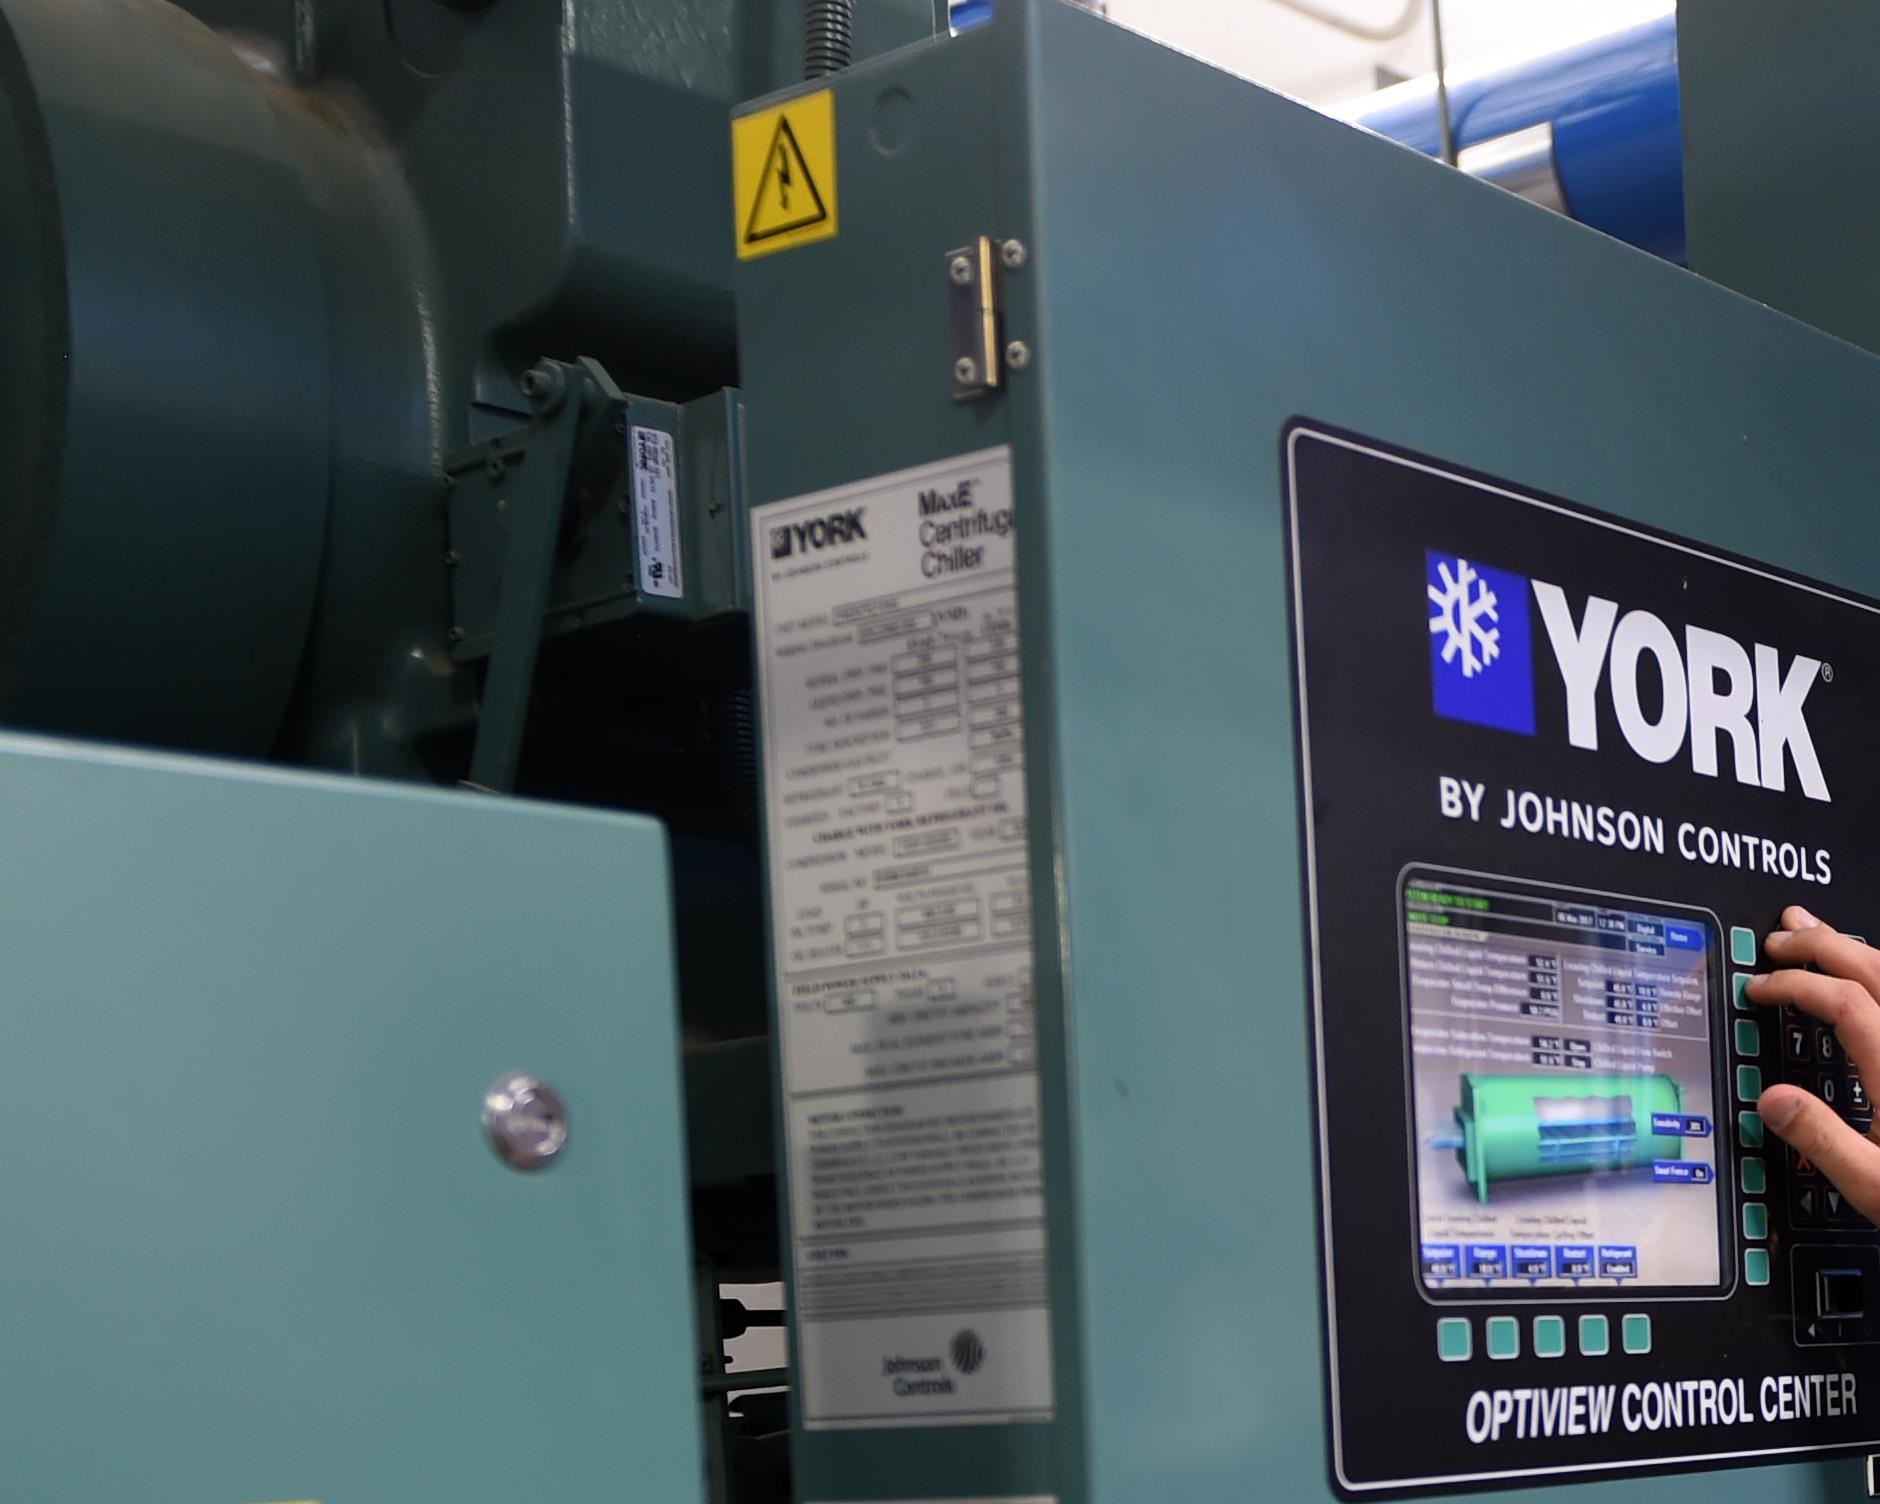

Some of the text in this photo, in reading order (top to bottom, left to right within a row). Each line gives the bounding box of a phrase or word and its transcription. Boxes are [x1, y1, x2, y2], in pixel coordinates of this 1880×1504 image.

[790, 506, 868, 554] YORK
[920, 546, 984, 579] Chiller
[1439, 775, 1832, 885] BY JOHNSON CONTROLS
[1792, 1032, 1833, 1058] 7 8
[1824, 1080, 1834, 1102] 0
[882, 1354, 941, 1376] Johnson
[893, 1376, 956, 1397] Controls
[1466, 1372, 1858, 1443] OPTIVIEW CONTROL CENTER
